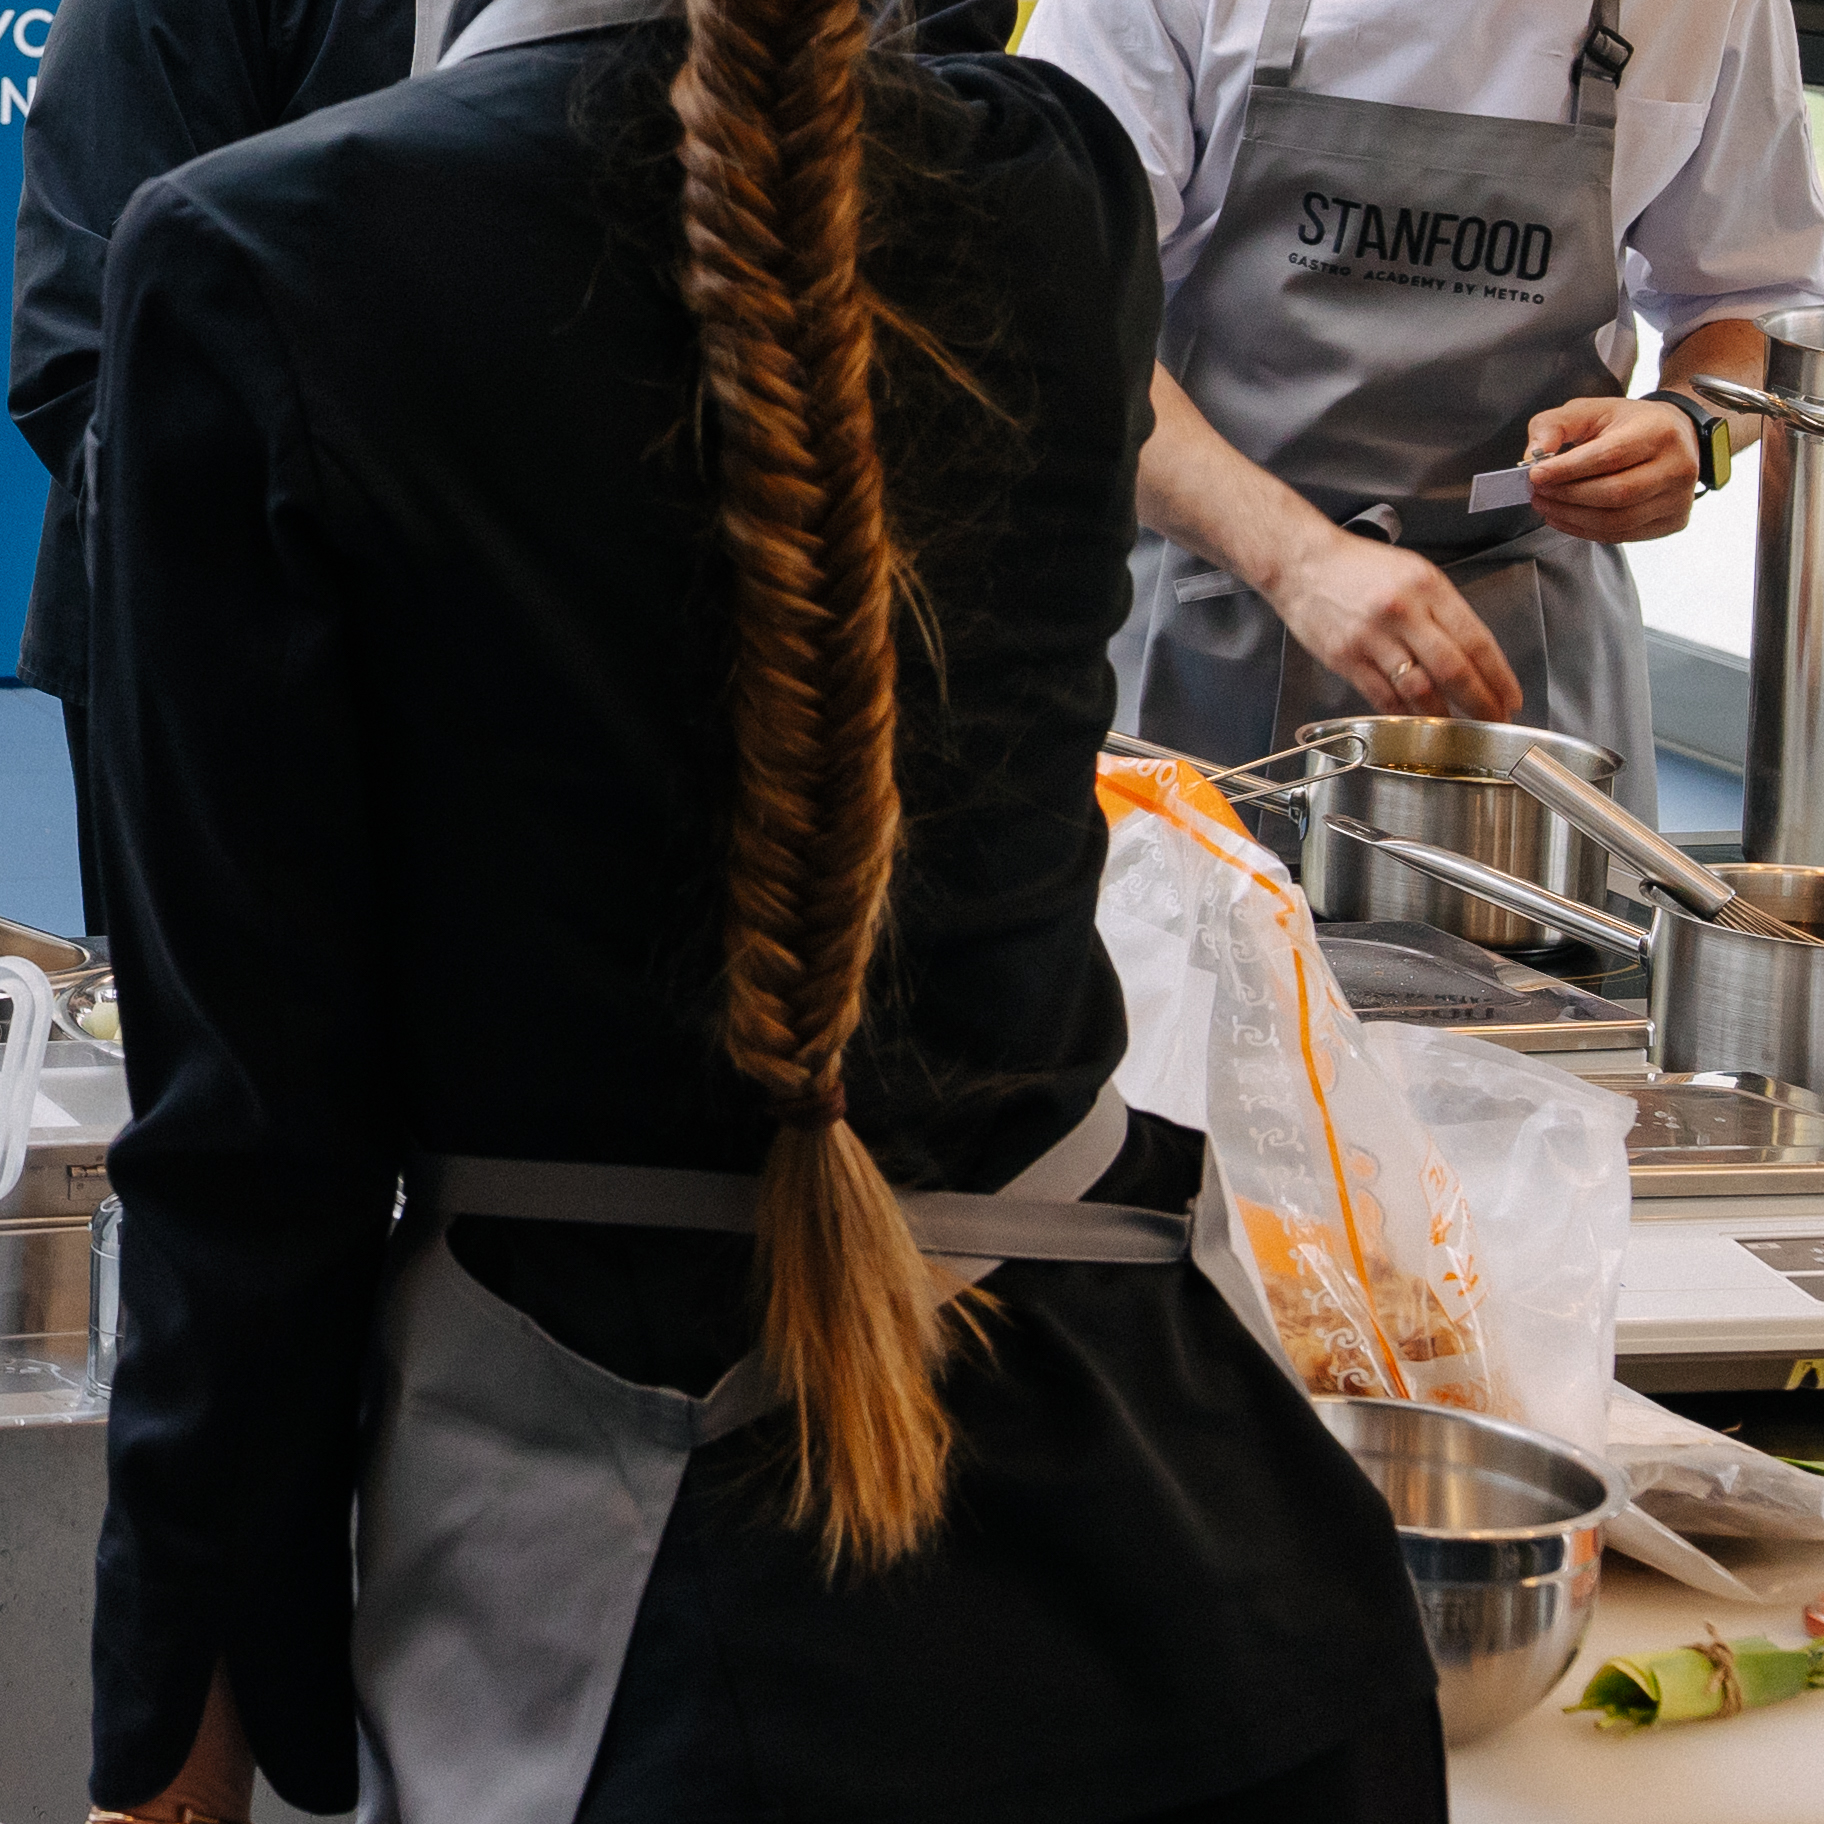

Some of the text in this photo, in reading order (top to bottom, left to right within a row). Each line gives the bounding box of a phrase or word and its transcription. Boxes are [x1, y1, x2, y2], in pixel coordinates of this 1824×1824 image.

[1297, 191, 1553, 282] STANFOOD
[1288, 252, 1546, 305] GASTRO ACADEMY BY METRO
